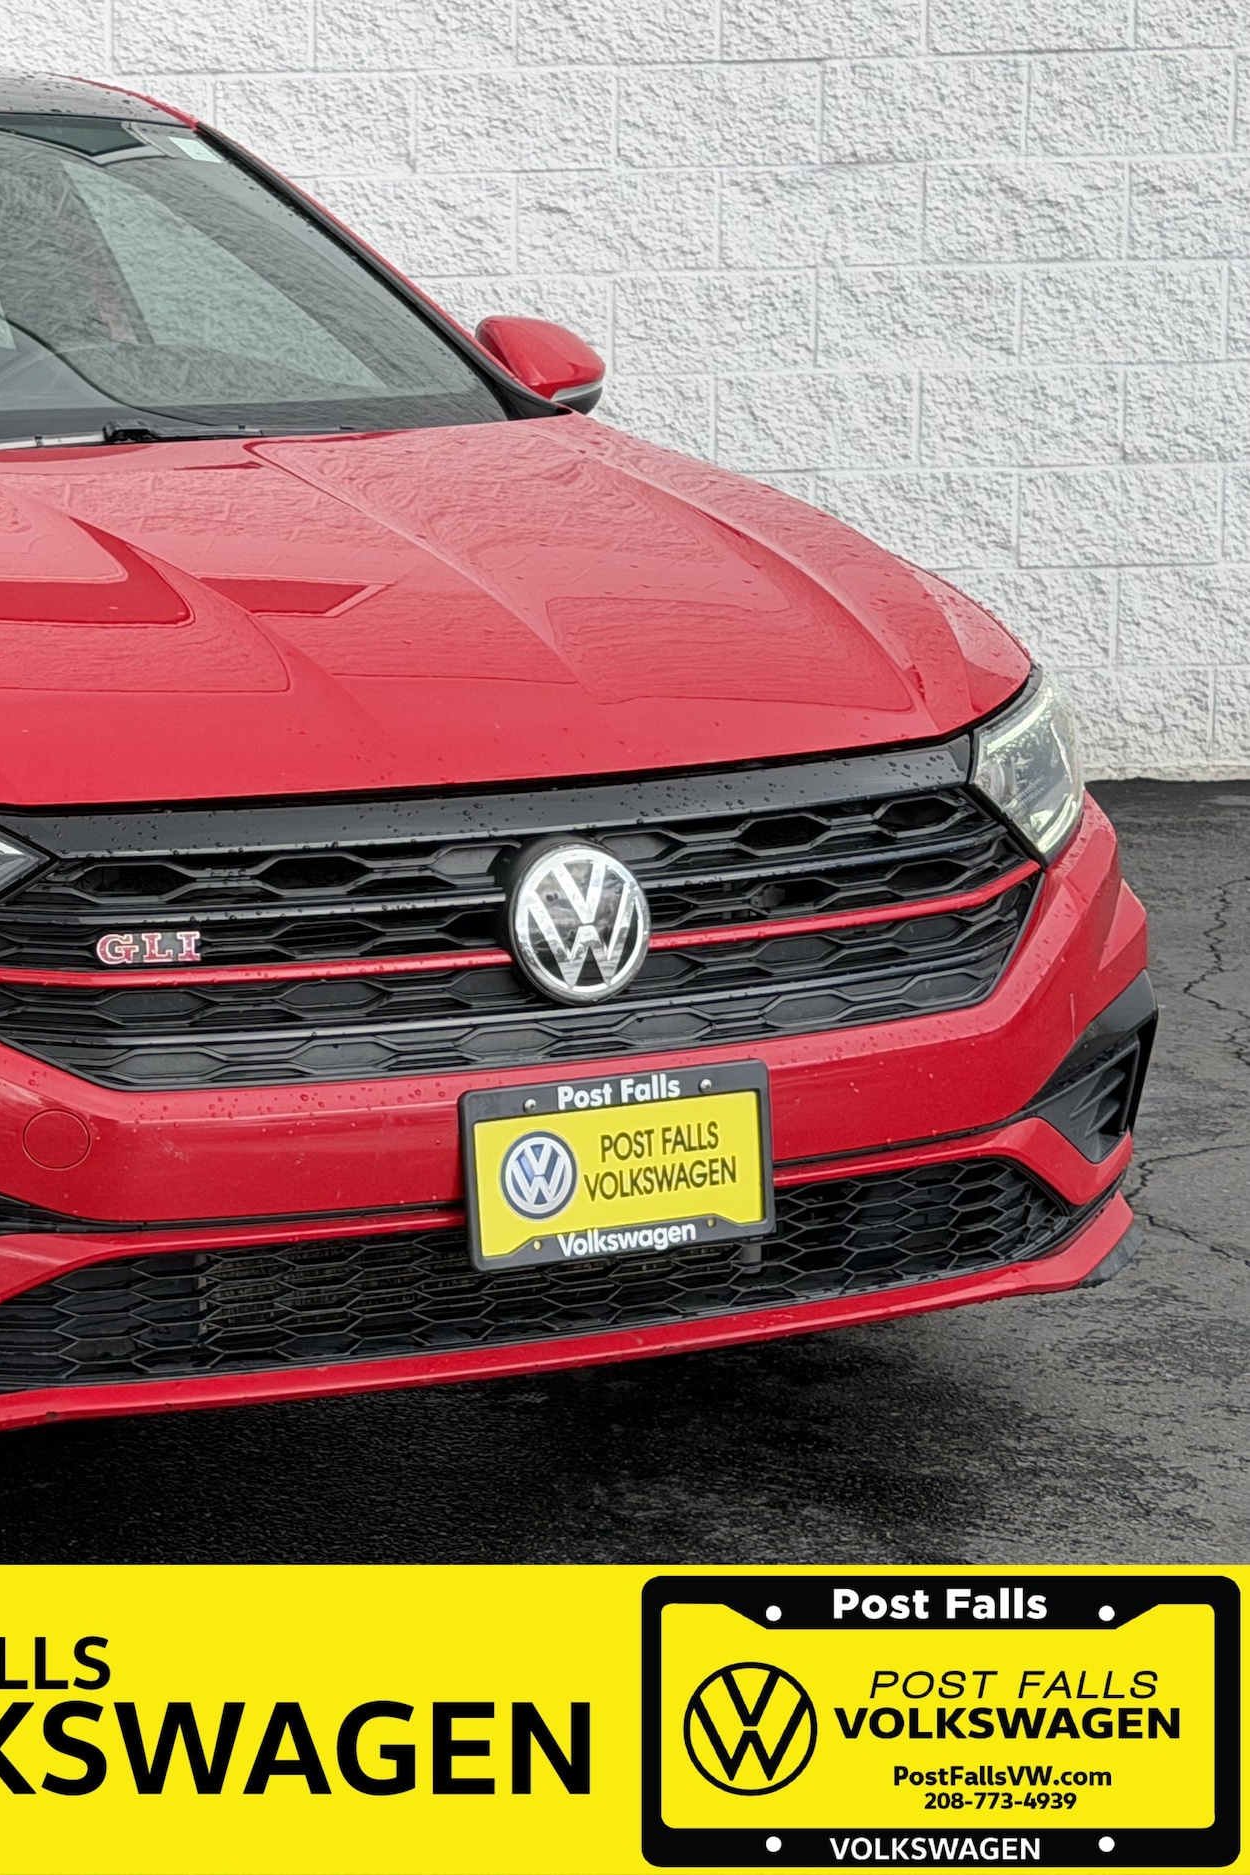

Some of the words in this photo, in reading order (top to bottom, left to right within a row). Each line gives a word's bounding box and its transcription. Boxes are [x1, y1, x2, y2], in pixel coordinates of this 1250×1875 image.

[512, 843, 651, 1003] VW
[96, 931, 201, 965] GLI
[557, 1085, 612, 1111] Post
[620, 1073, 680, 1104] Falls
[600, 1129, 654, 1163] POST
[662, 1121, 719, 1155] FALLS
[501, 1131, 577, 1219] VW
[583, 1156, 737, 1201] VOLKSWAGEN
[557, 1223, 696, 1257] Volkswagen
